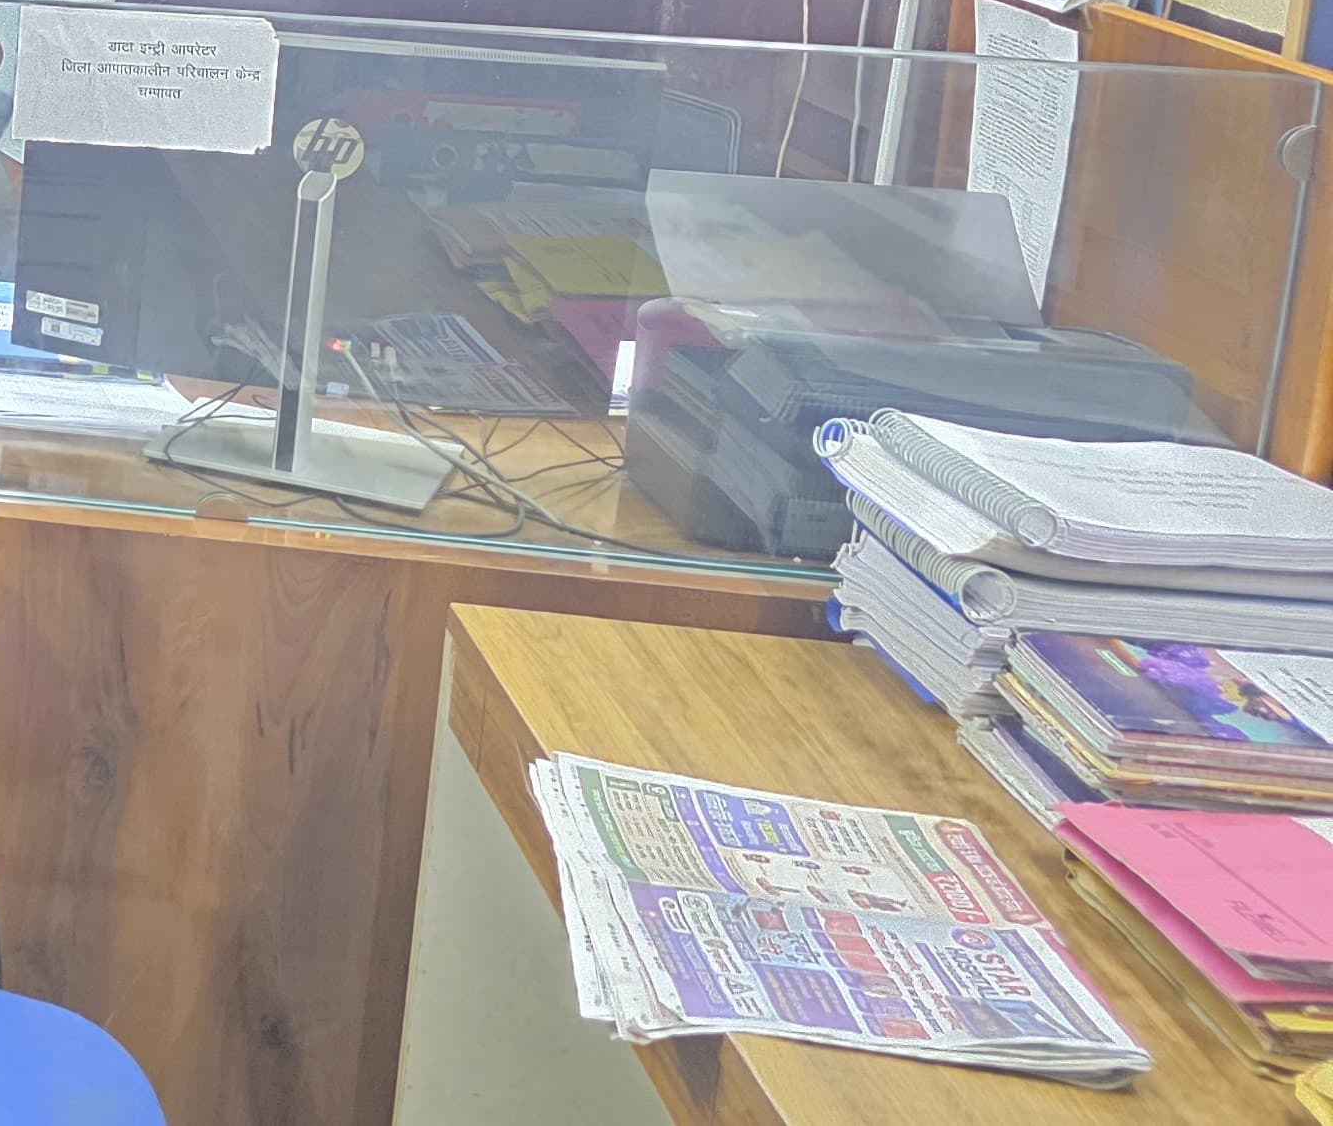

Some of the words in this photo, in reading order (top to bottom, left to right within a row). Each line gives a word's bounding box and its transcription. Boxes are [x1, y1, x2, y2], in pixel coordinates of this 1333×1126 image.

[61, 57, 92, 74] जिला
[97, 61, 171, 77] आपातकालीन
[176, 63, 230, 80] परिचालन
[235, 65, 262, 82] केन्द्र
[300, 117, 359, 174] hp
[974, 951, 1032, 998] STAR
